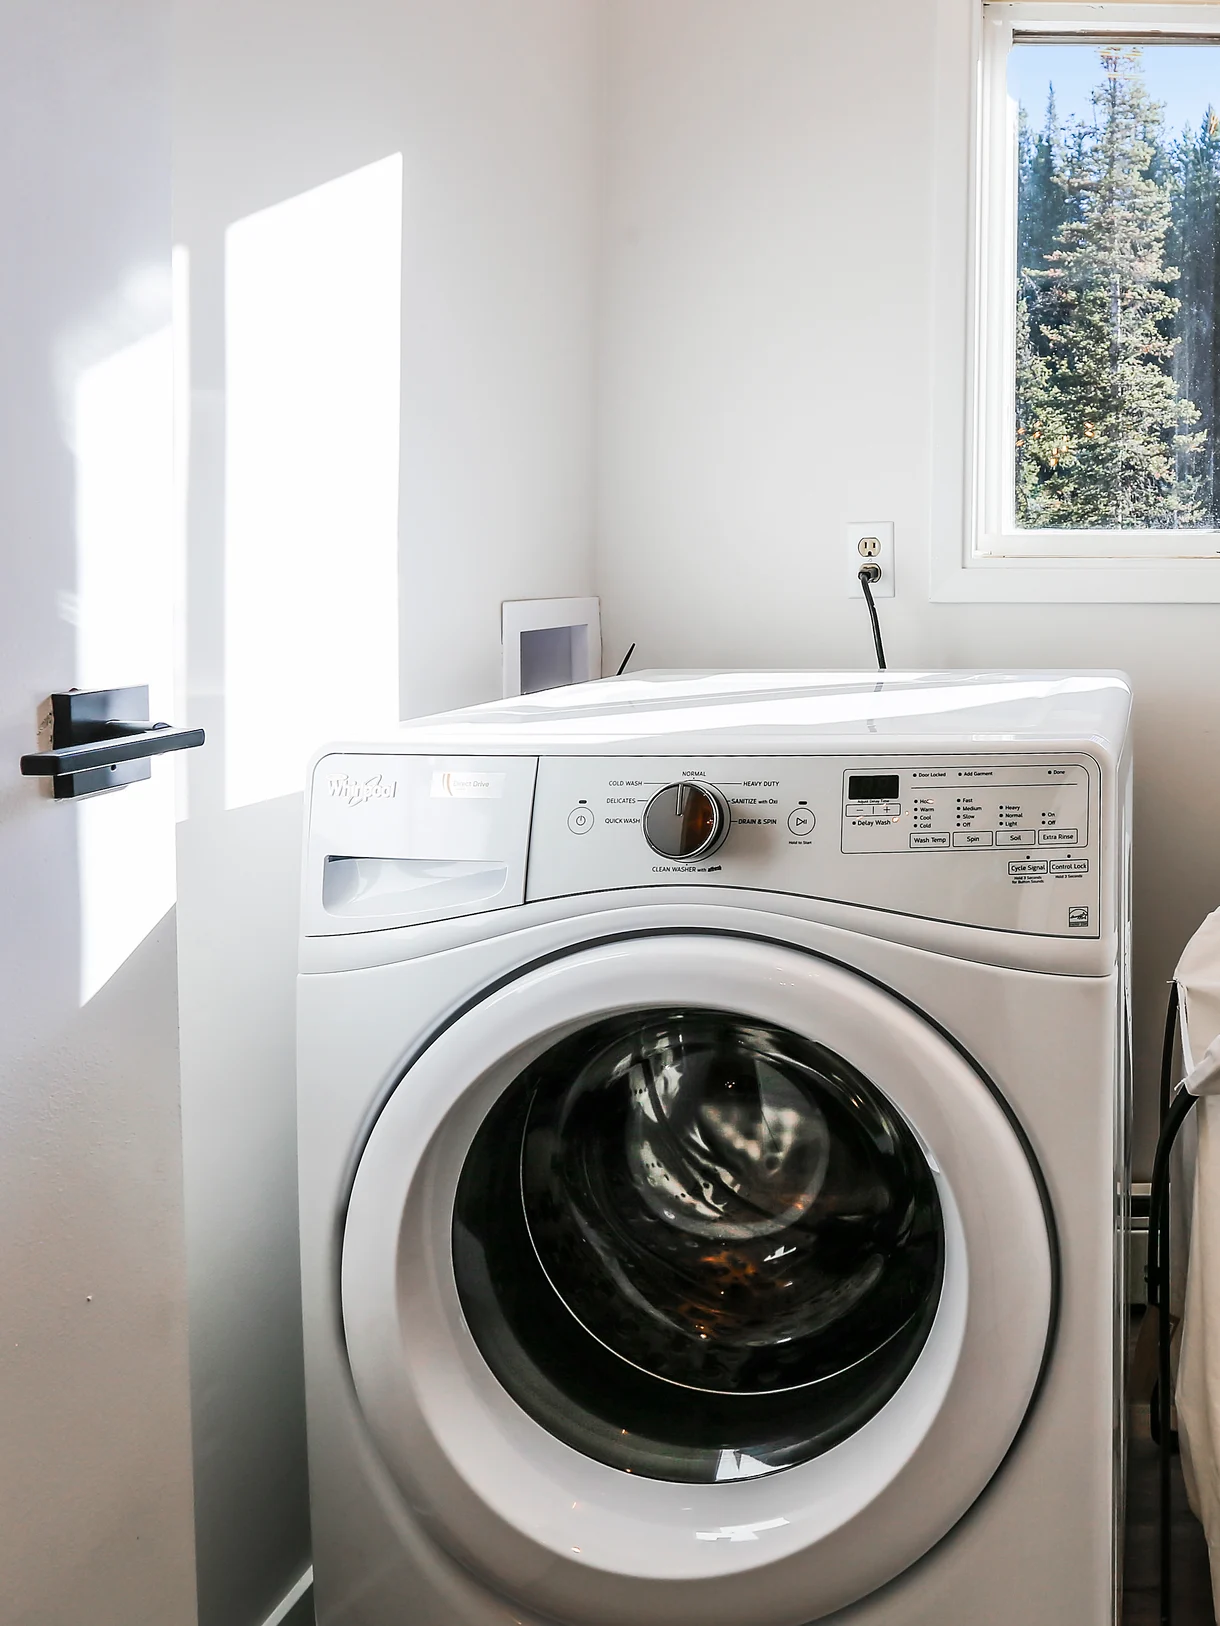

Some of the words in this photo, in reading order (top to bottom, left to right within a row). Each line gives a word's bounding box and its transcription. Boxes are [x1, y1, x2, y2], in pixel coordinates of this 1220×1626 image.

[472, 780, 490, 788] Drive
[326, 773, 398, 807] Whirlpool
[1027, 864, 1046, 872] Signal
